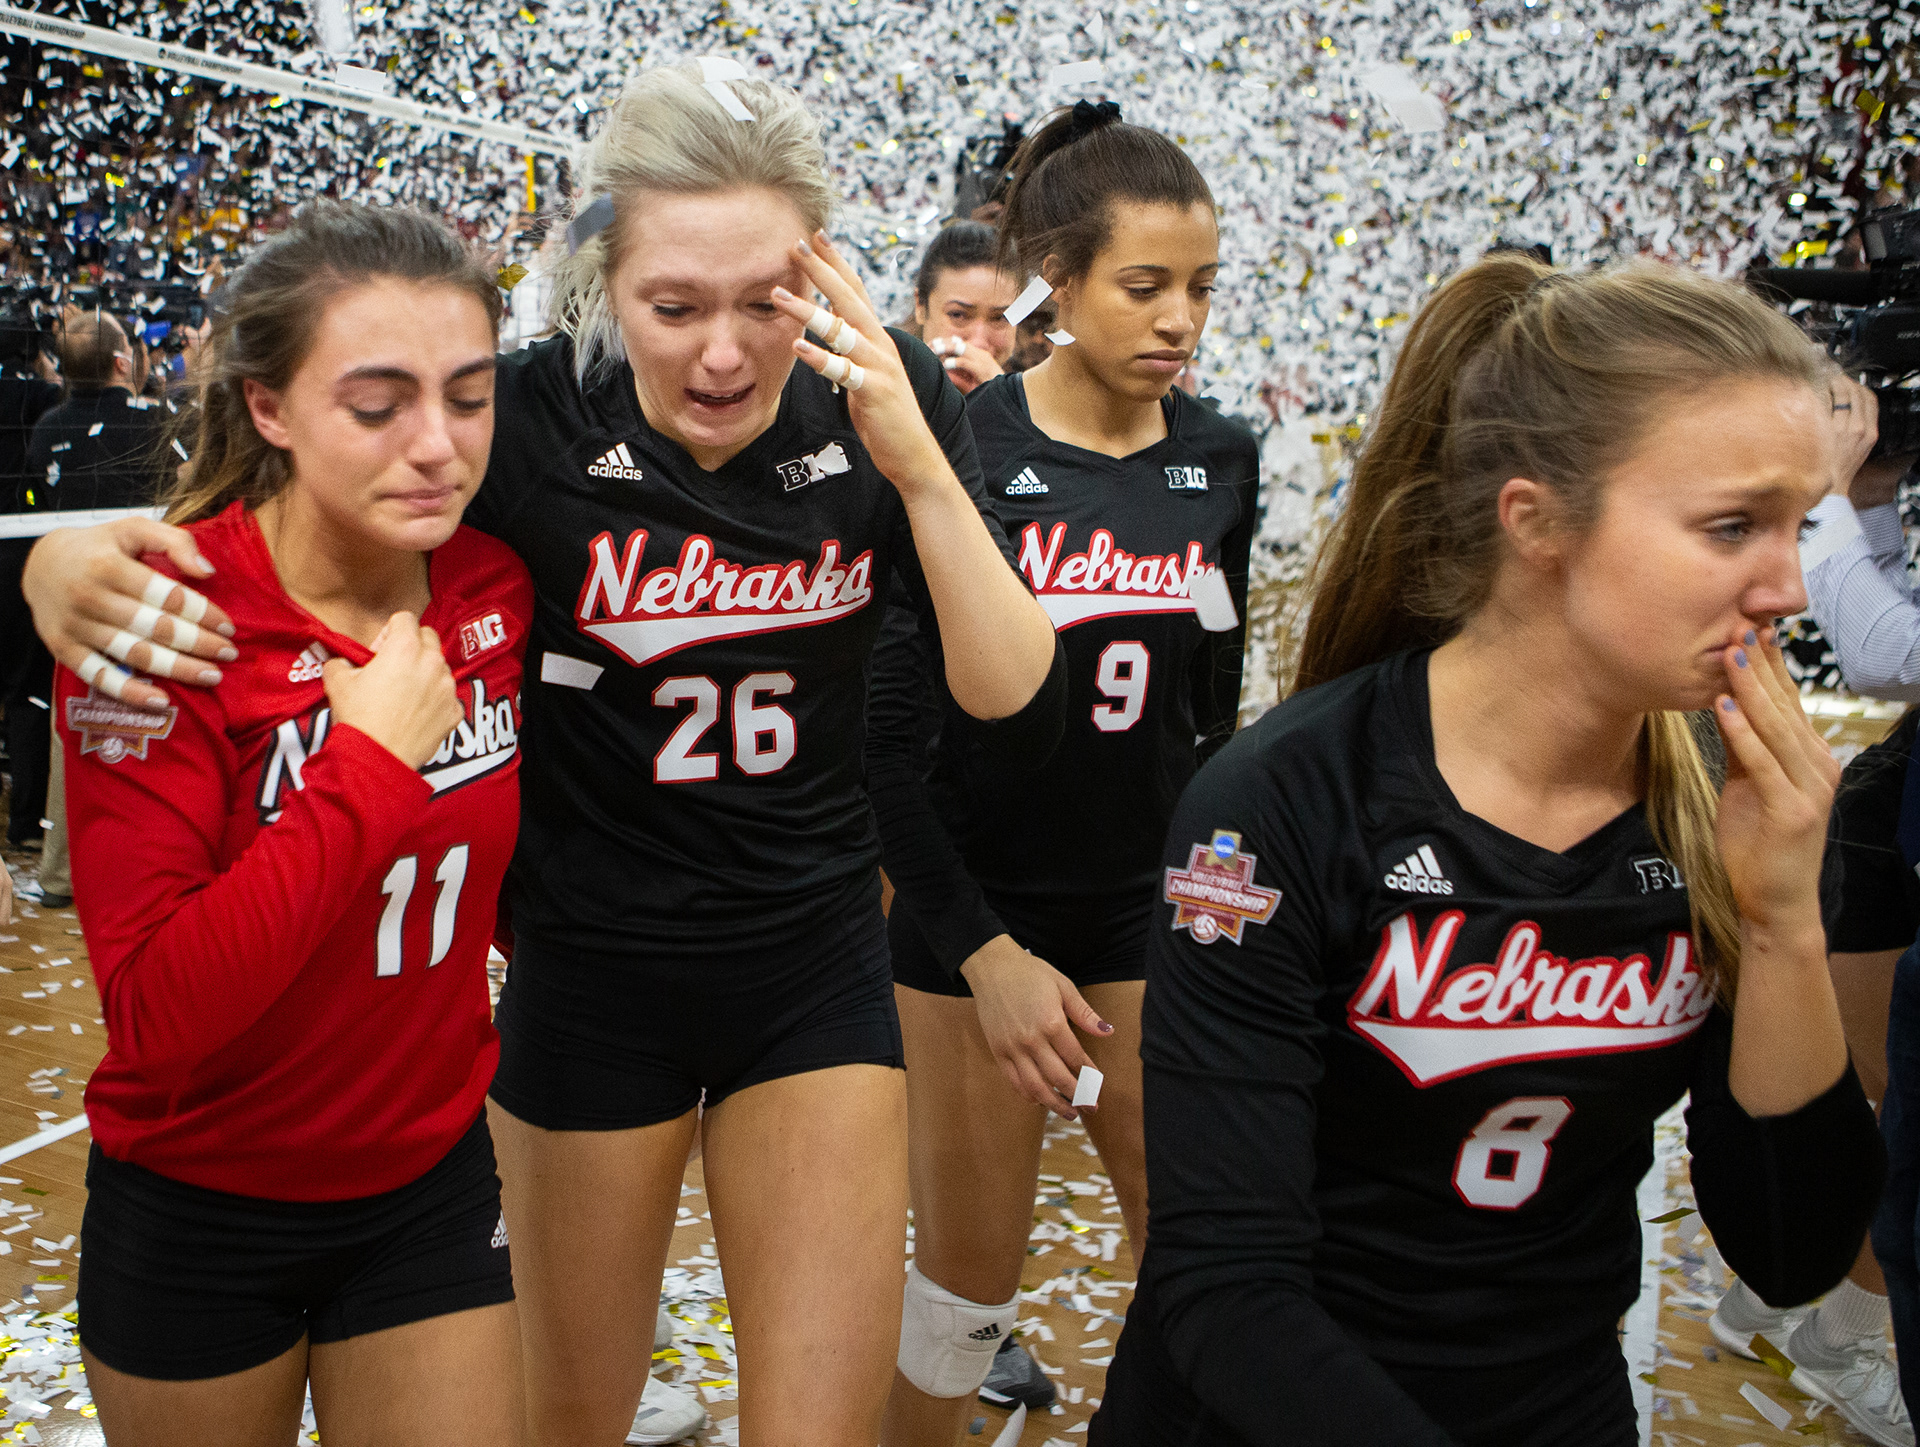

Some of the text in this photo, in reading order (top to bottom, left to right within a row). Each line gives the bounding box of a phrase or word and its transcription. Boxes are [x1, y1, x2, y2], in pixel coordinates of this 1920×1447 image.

[587, 462, 643, 481] adidas
[1005, 481, 1049, 495] adidas
[575, 529, 873, 624] Nebraska
[1018, 522, 1217, 600] Nebrask
[652, 670, 798, 784] 26
[1091, 641, 1150, 732] 9
[375, 842, 470, 979] 11
[1171, 878, 1269, 913] CHAMPIONSHIP
[1384, 872, 1454, 896] adidas
[1451, 1096, 1575, 1212] 8
